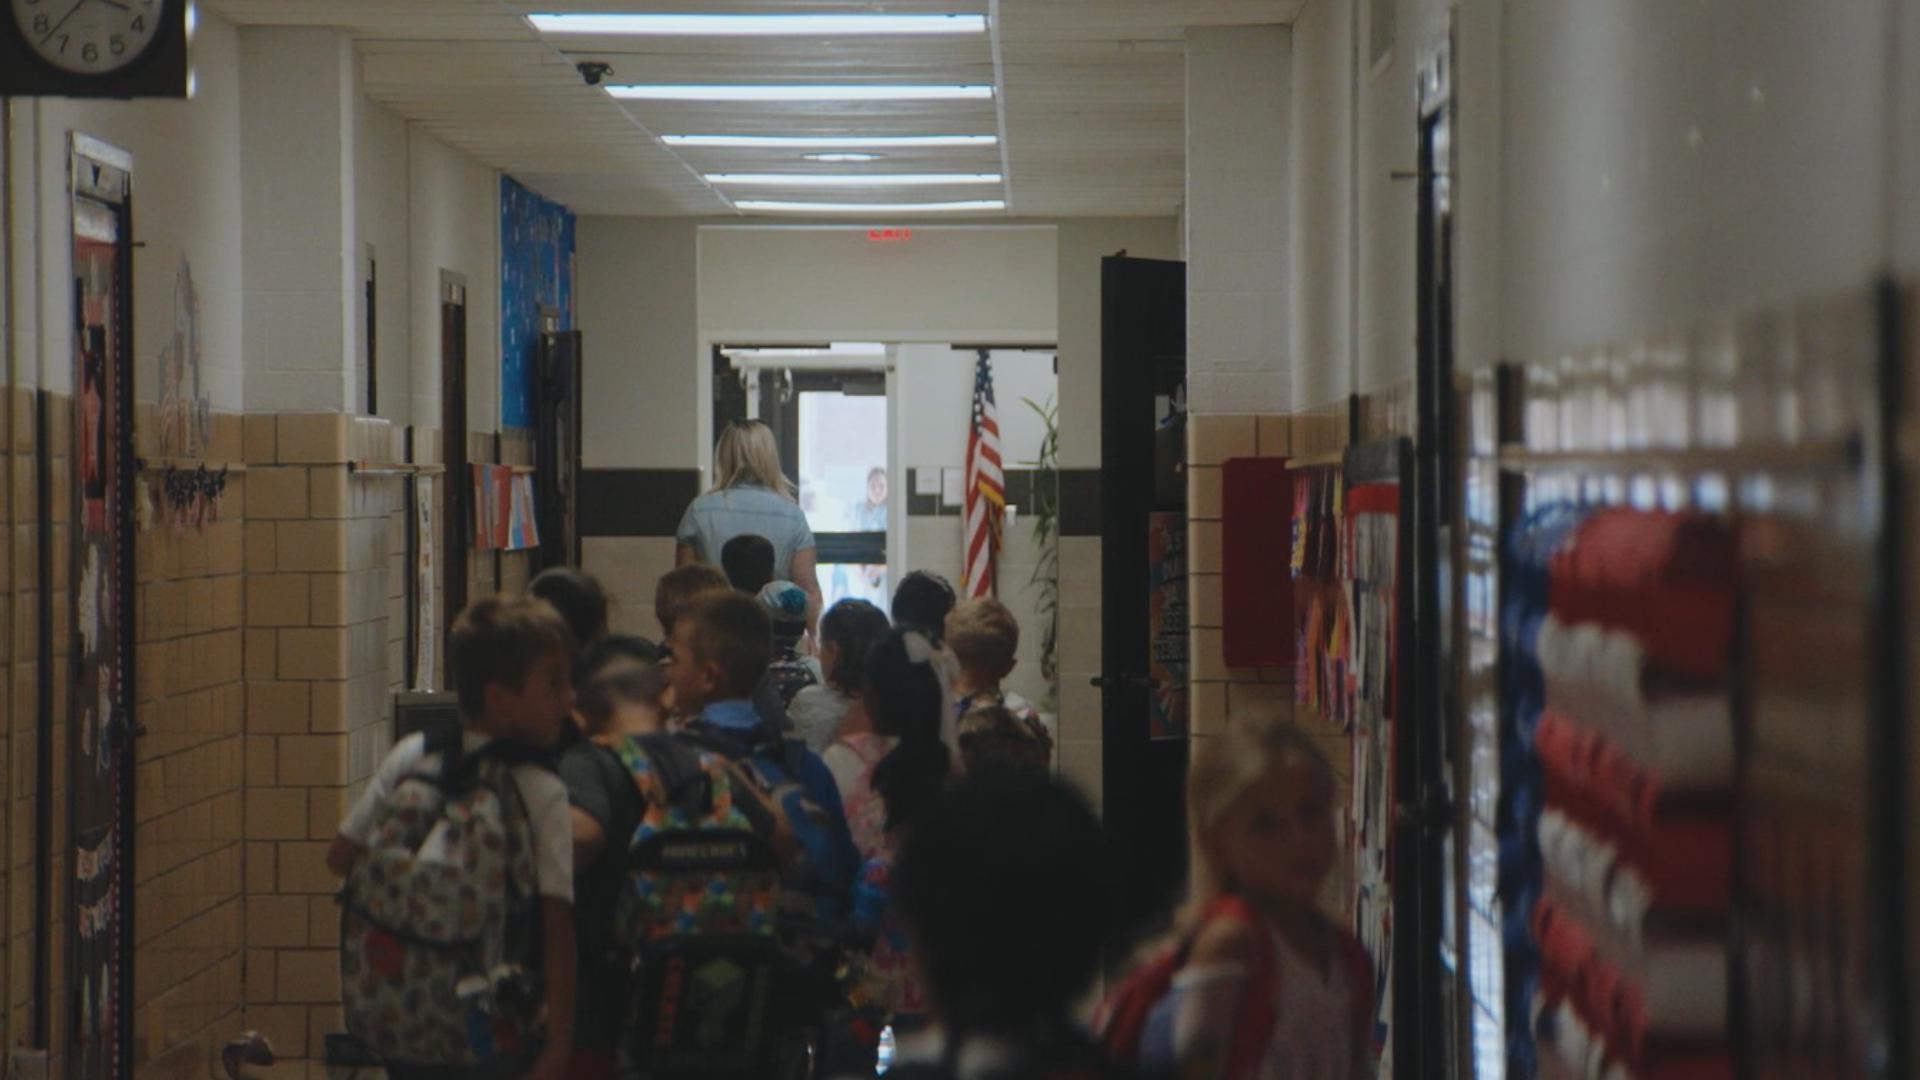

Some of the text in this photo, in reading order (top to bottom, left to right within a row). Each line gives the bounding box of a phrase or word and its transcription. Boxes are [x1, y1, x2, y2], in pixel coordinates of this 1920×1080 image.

[33, 13, 49, 33] 8
[130, 15, 144, 33] 4
[57, 34, 70, 54] 7
[81, 42, 98, 63] 6
[110, 34, 125, 55] 5
